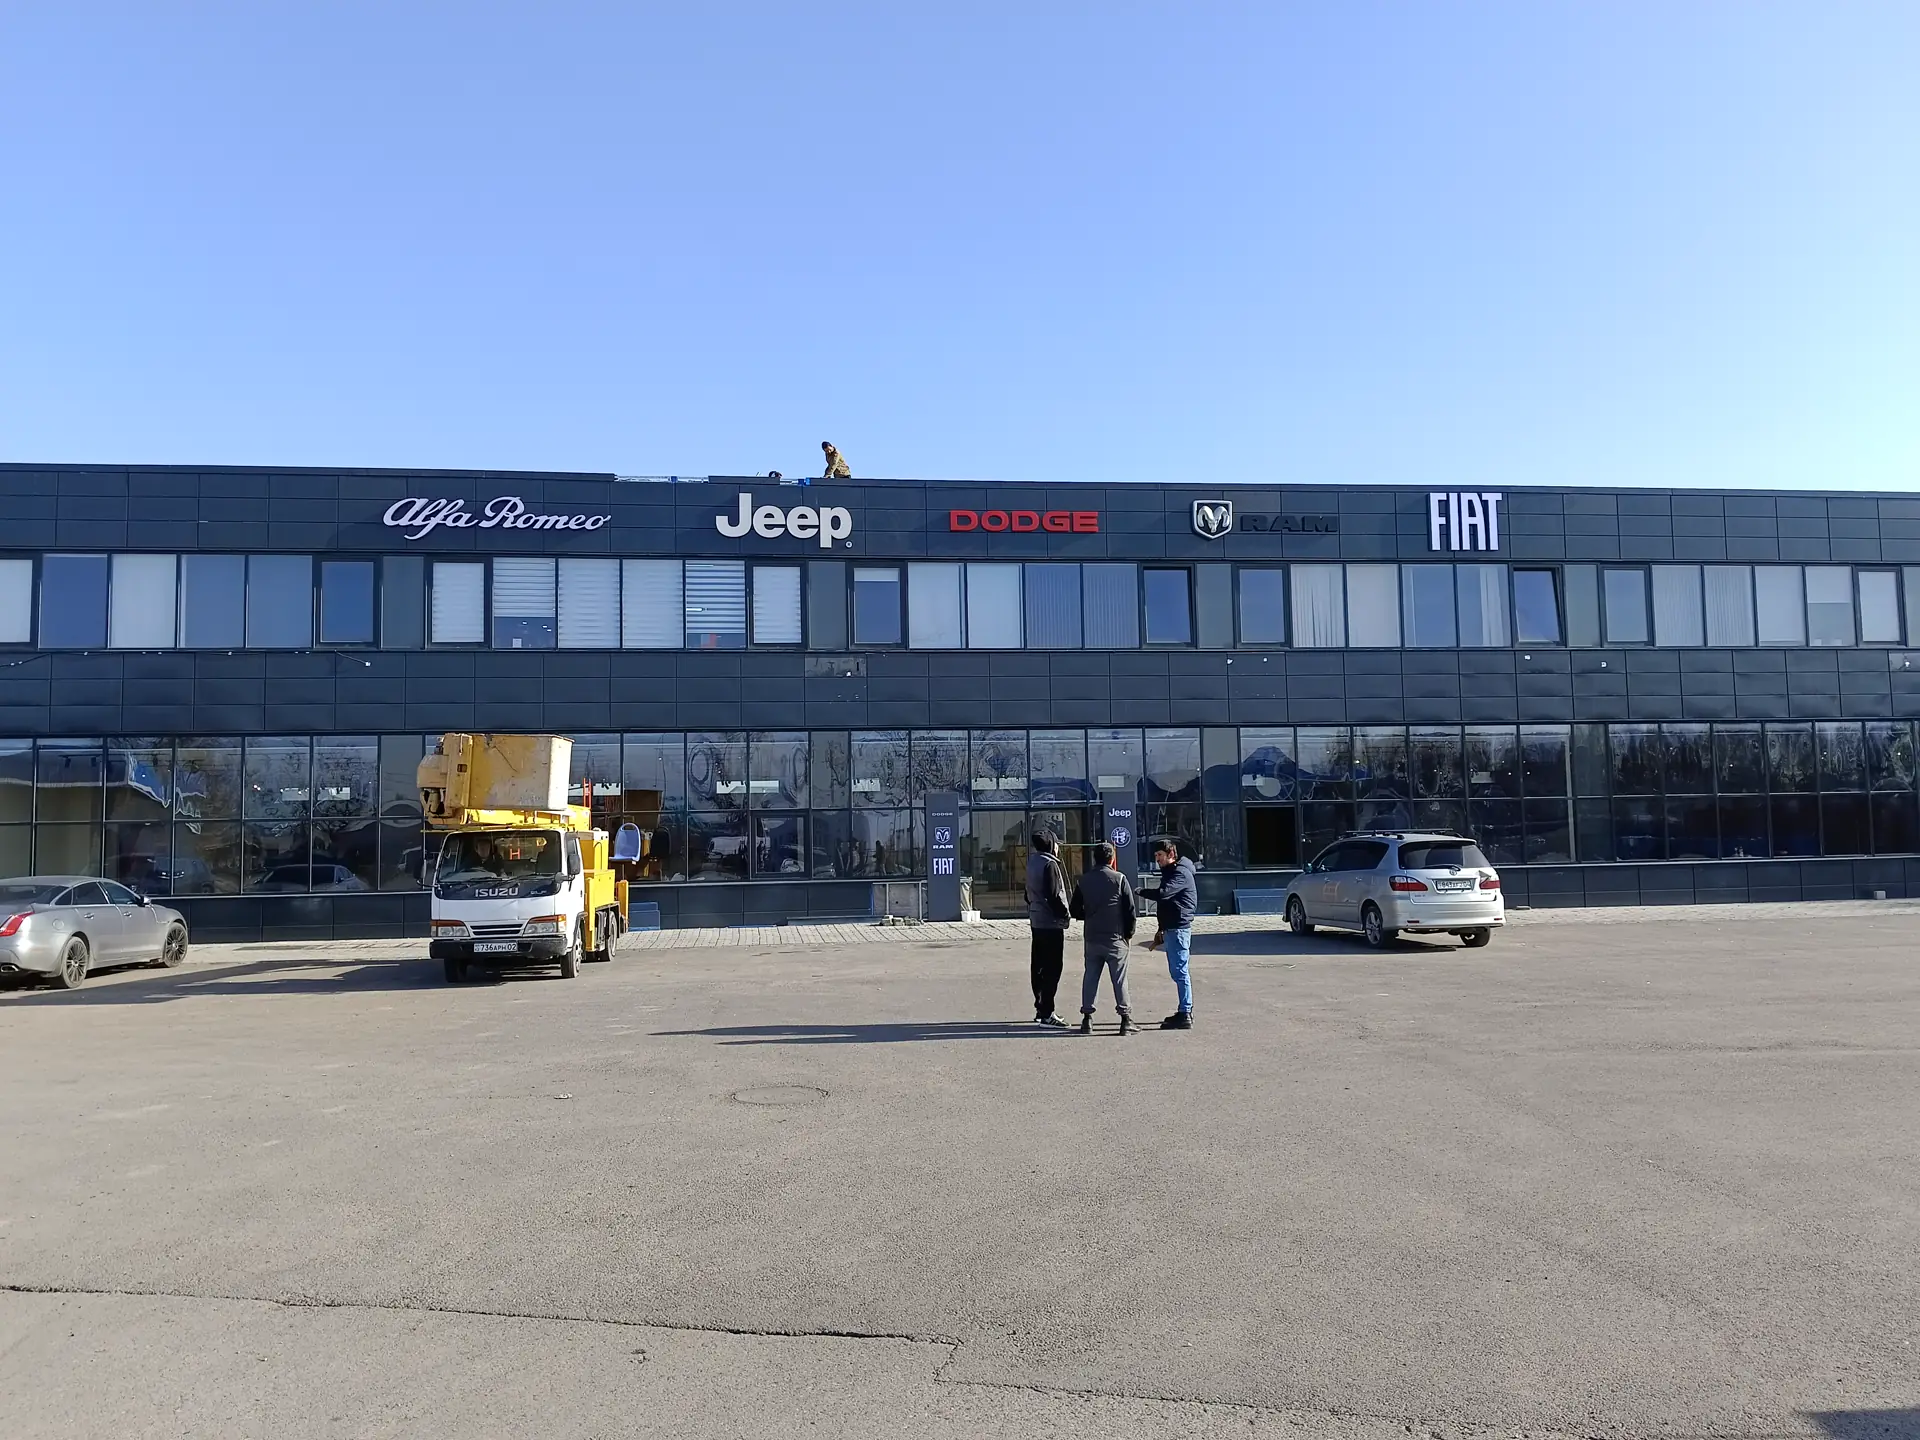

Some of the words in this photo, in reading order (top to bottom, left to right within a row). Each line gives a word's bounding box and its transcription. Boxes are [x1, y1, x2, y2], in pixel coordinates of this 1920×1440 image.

[382, 498, 478, 540] Alfa
[478, 496, 612, 531] Romeo
[715, 492, 853, 549] Jeep
[949, 510, 1100, 533] DODGE
[1240, 514, 1339, 533] RAM
[1428, 492, 1503, 551] FIAT
[1108, 807, 1132, 819] Jeep
[933, 857, 955, 875] FIAT
[475, 887, 519, 898] ISUZU
